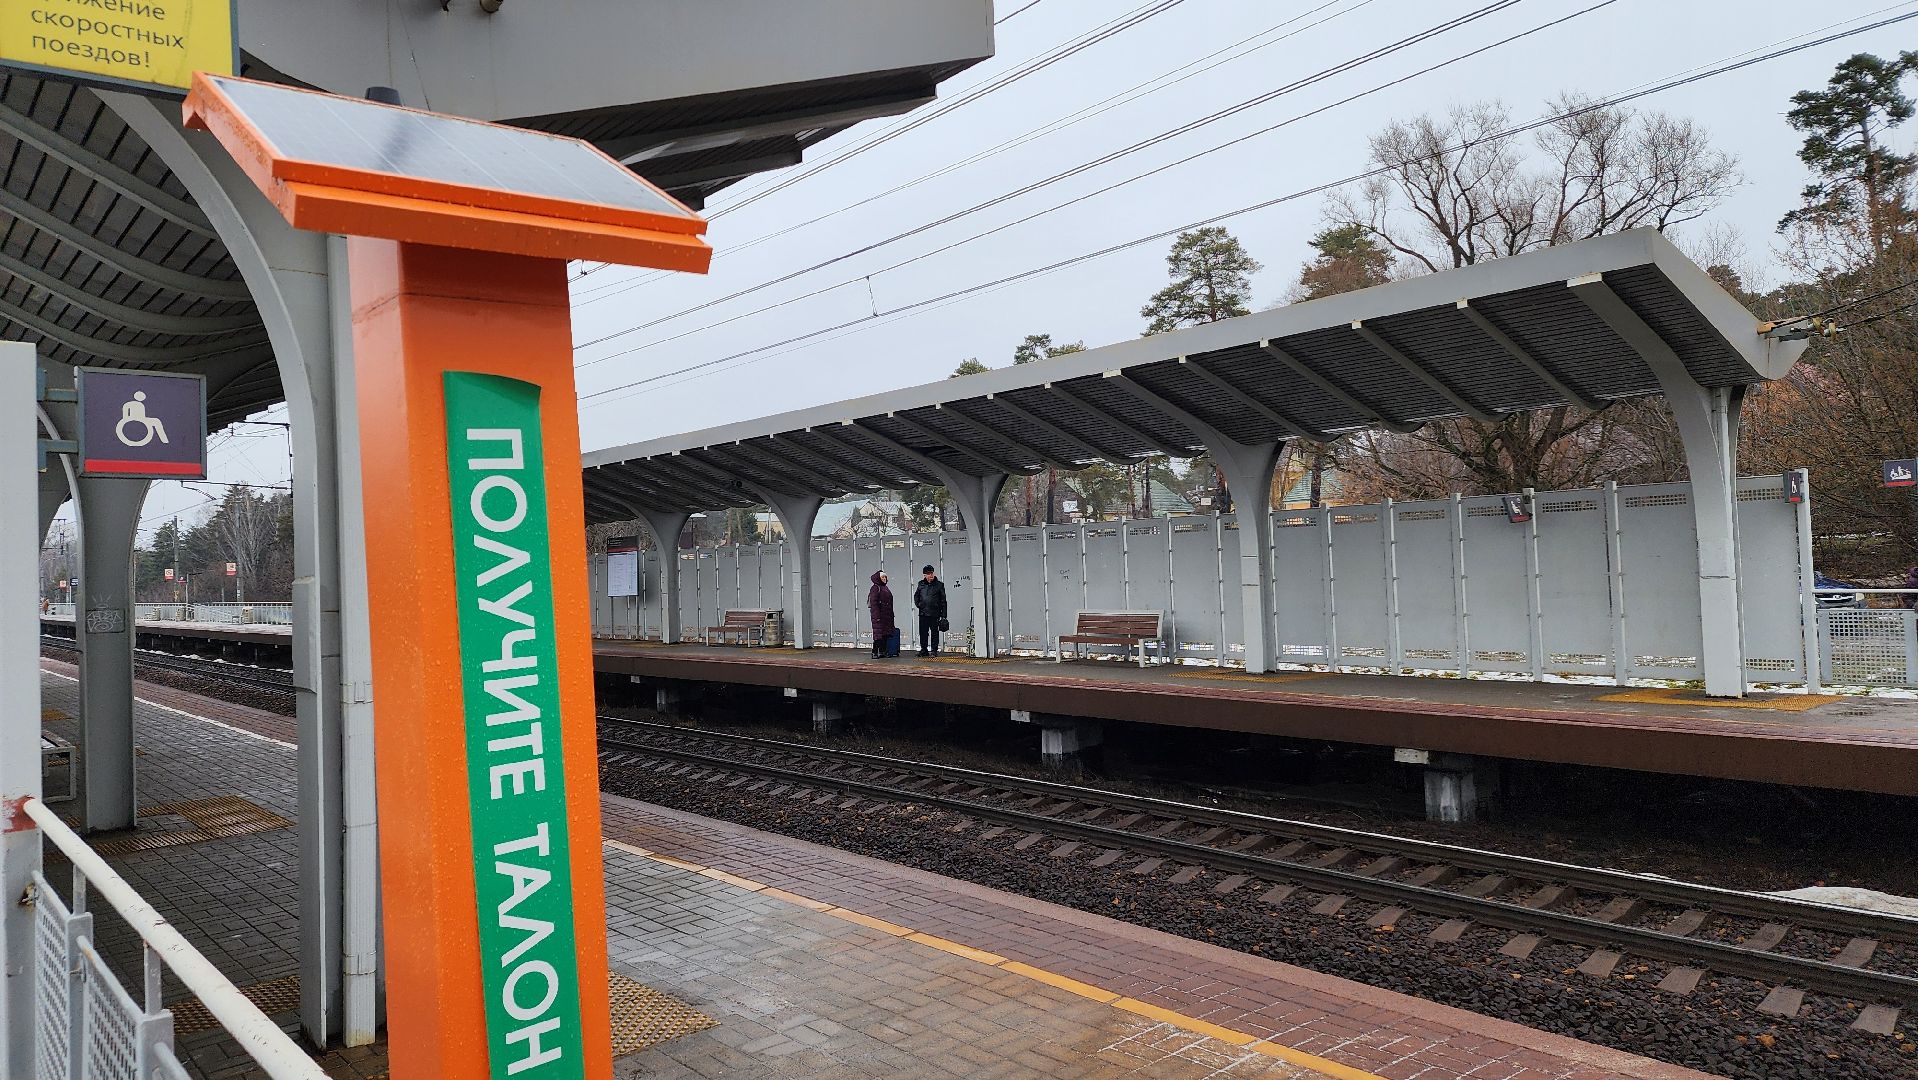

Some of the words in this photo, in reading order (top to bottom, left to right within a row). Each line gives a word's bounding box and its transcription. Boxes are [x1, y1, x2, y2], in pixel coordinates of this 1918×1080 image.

[31, 10, 185, 49] скоростных
[32, 36, 149, 68] поездов!
[467, 428, 546, 800] ПОЛУЧИТЕ
[494, 822, 562, 1075] ТАЛОН
